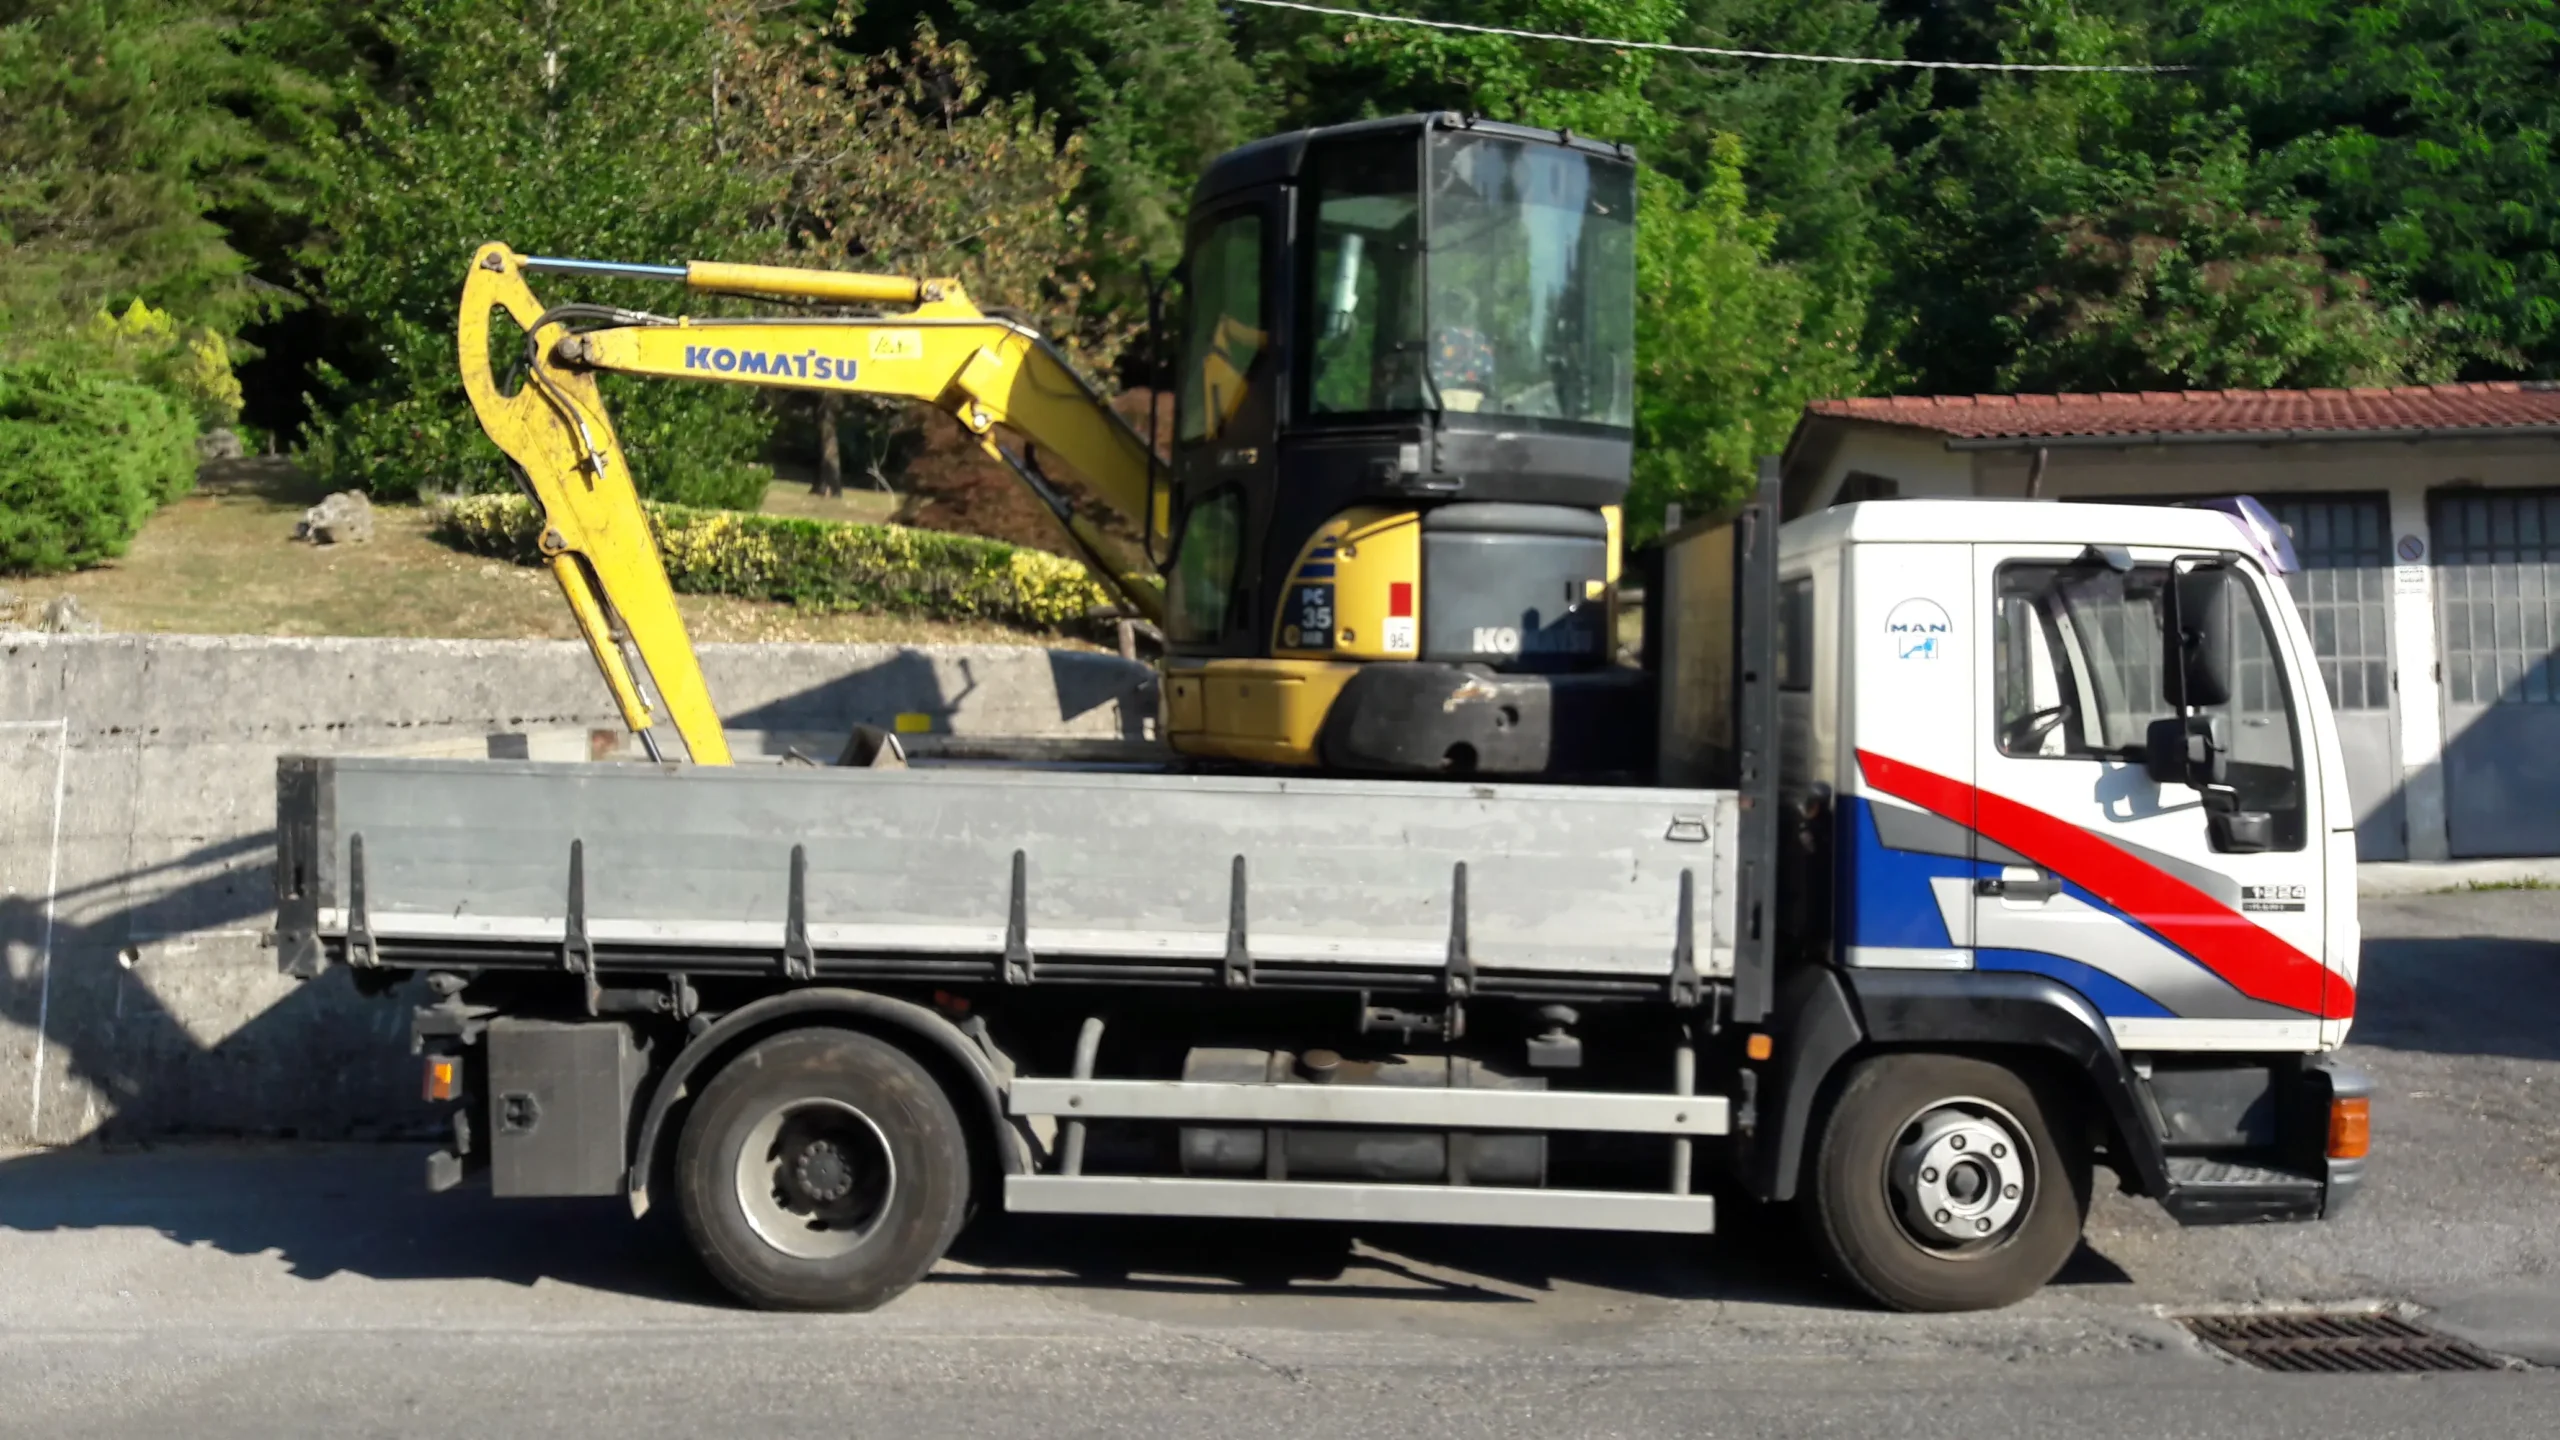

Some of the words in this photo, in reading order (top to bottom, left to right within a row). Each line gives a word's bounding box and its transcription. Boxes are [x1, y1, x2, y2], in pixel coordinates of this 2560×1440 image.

[684, 345, 857, 381] KOMATSU
[1302, 587, 1325, 606] PC
[1301, 606, 1332, 630] 35
[1890, 623, 1946, 633] MAN
